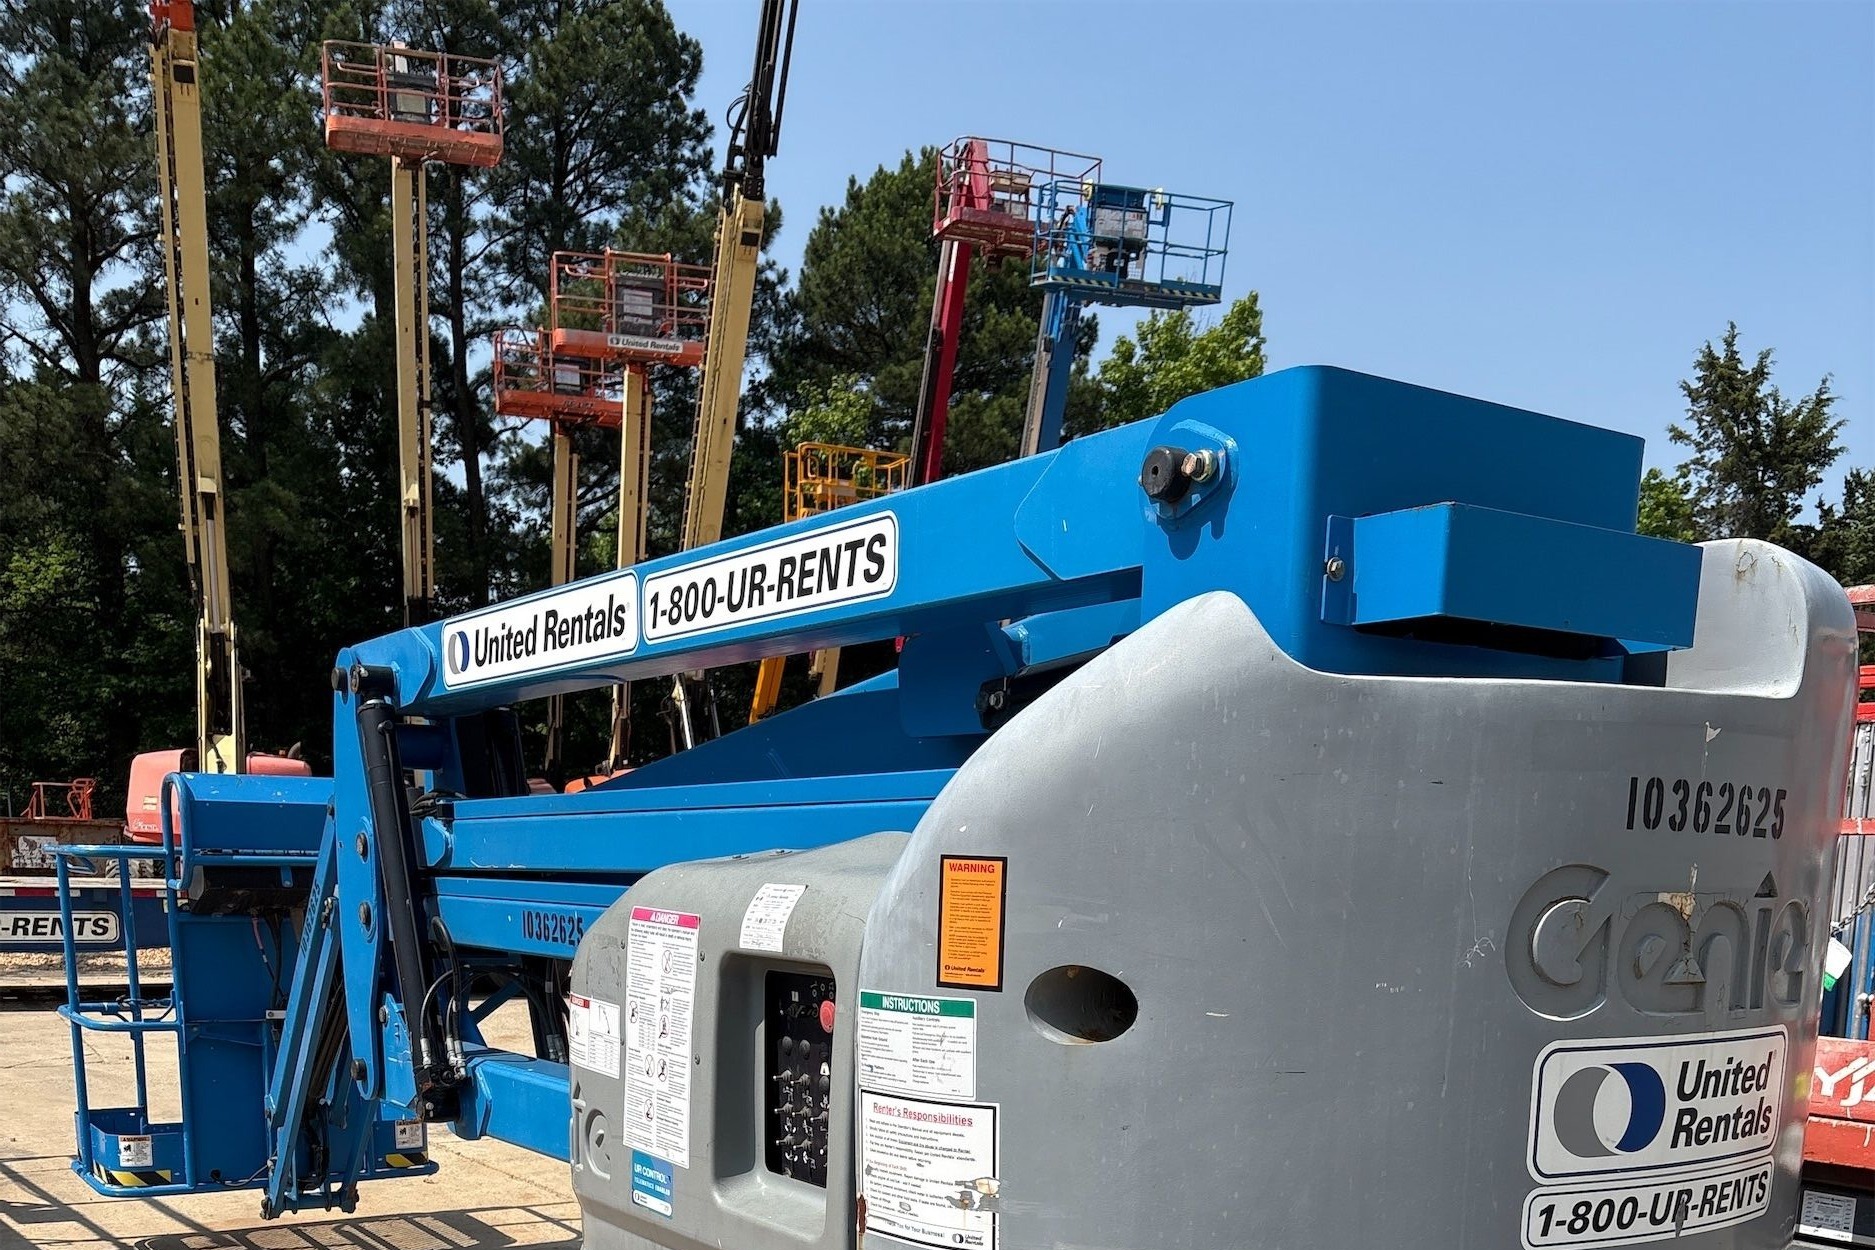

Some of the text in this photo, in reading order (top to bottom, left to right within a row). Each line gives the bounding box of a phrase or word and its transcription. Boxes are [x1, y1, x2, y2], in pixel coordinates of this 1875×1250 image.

[622, 338, 680, 351] United Rentals
[649, 532, 887, 631] 1-800-UR-RENTS
[474, 593, 626, 668] United Rentals
[949, 862, 995, 874] WARNING
[0, 917, 110, 937] -RENTS
[655, 912, 680, 925] DANGER
[1504, 863, 1808, 1022] Genie
[882, 997, 941, 1014] INSTRUCTIONS
[1676, 1051, 1774, 1102] United
[873, 1102, 973, 1127] Renter's Responsibilities
[1670, 1096, 1773, 1149] Rentals
[1538, 1170, 1769, 1238] 1-800-UR-RENTS
